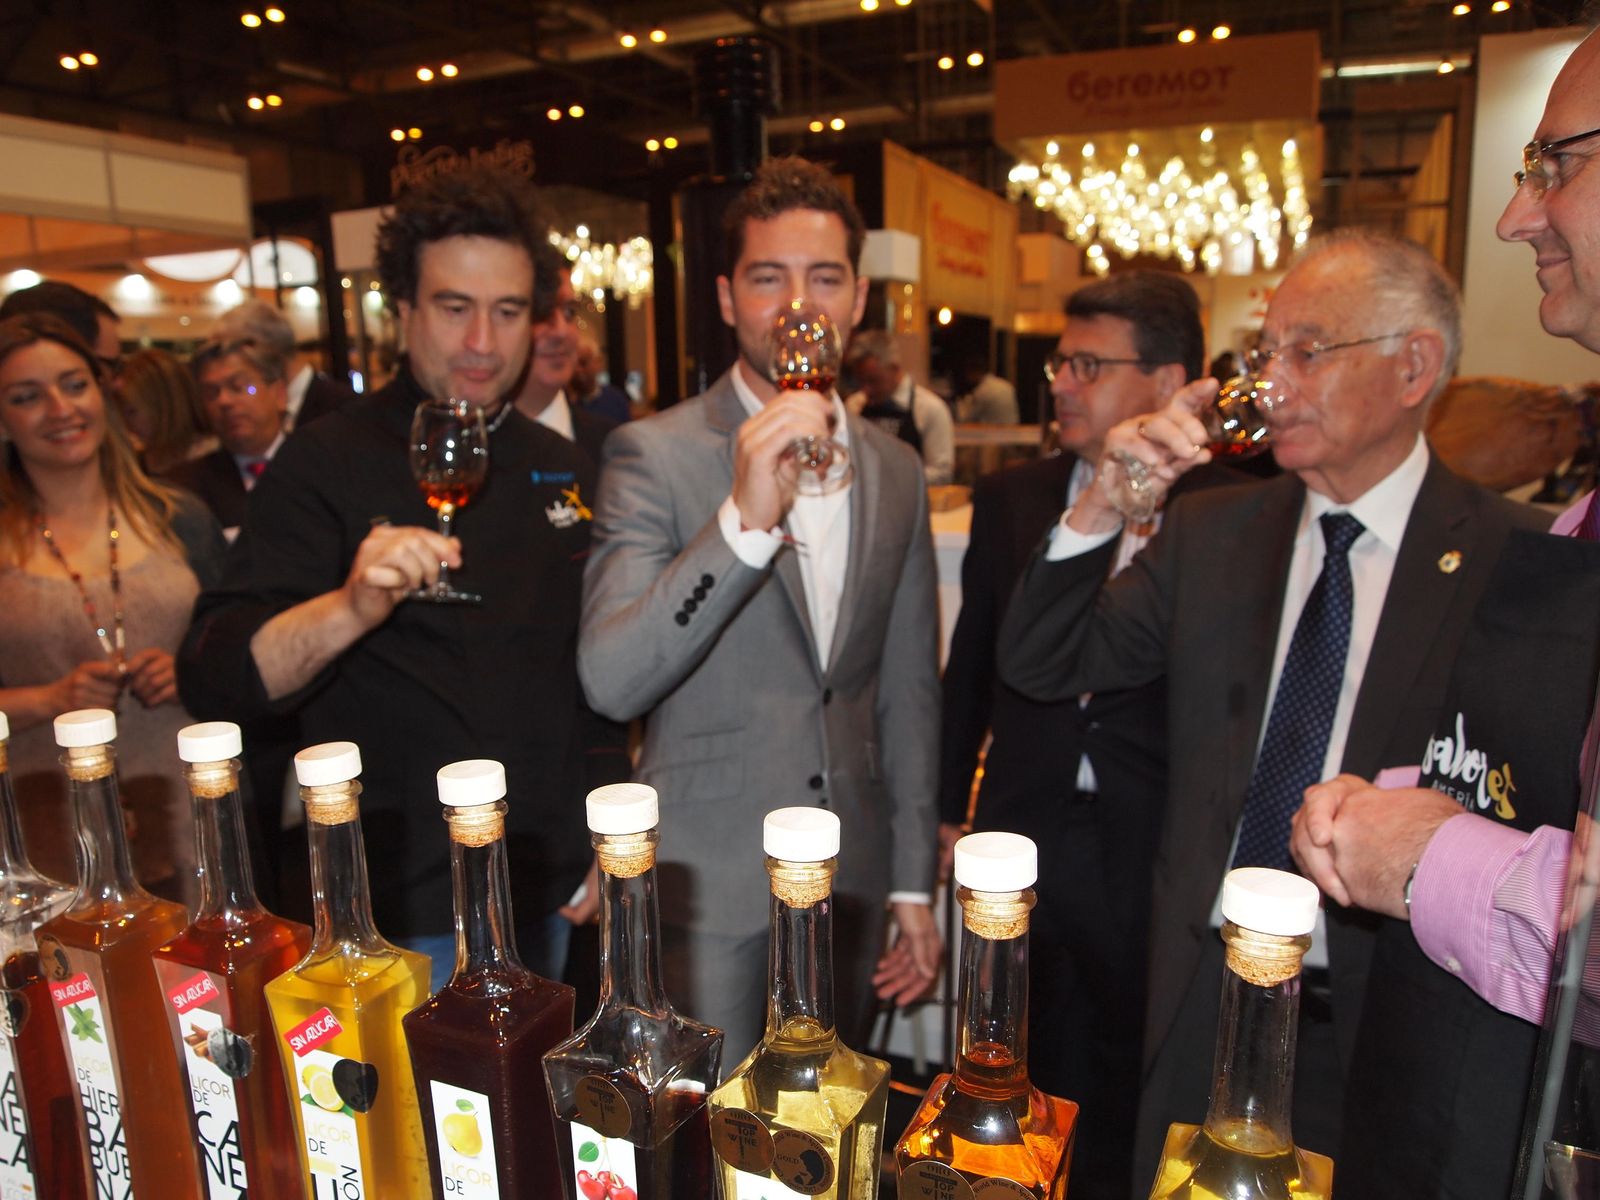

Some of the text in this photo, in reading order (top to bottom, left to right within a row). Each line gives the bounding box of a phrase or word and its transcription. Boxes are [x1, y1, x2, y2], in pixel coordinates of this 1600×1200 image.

[53, 989, 66, 1001] SIN
[173, 977, 214, 1009] SIN AZÚCAR
[290, 1014, 338, 1051] SIN AZÚCAR
[77, 1067, 93, 1083] DE
[190, 1073, 232, 1100] LICOR
[193, 1089, 210, 1106] DE
[196, 1110, 242, 1160] CA
[307, 1120, 354, 1147] LICOR
[308, 1137, 328, 1156] DE
[776, 1153, 801, 1165] GOLD
[443, 1159, 496, 1190] LICOR
[445, 1176, 465, 1196] DE
